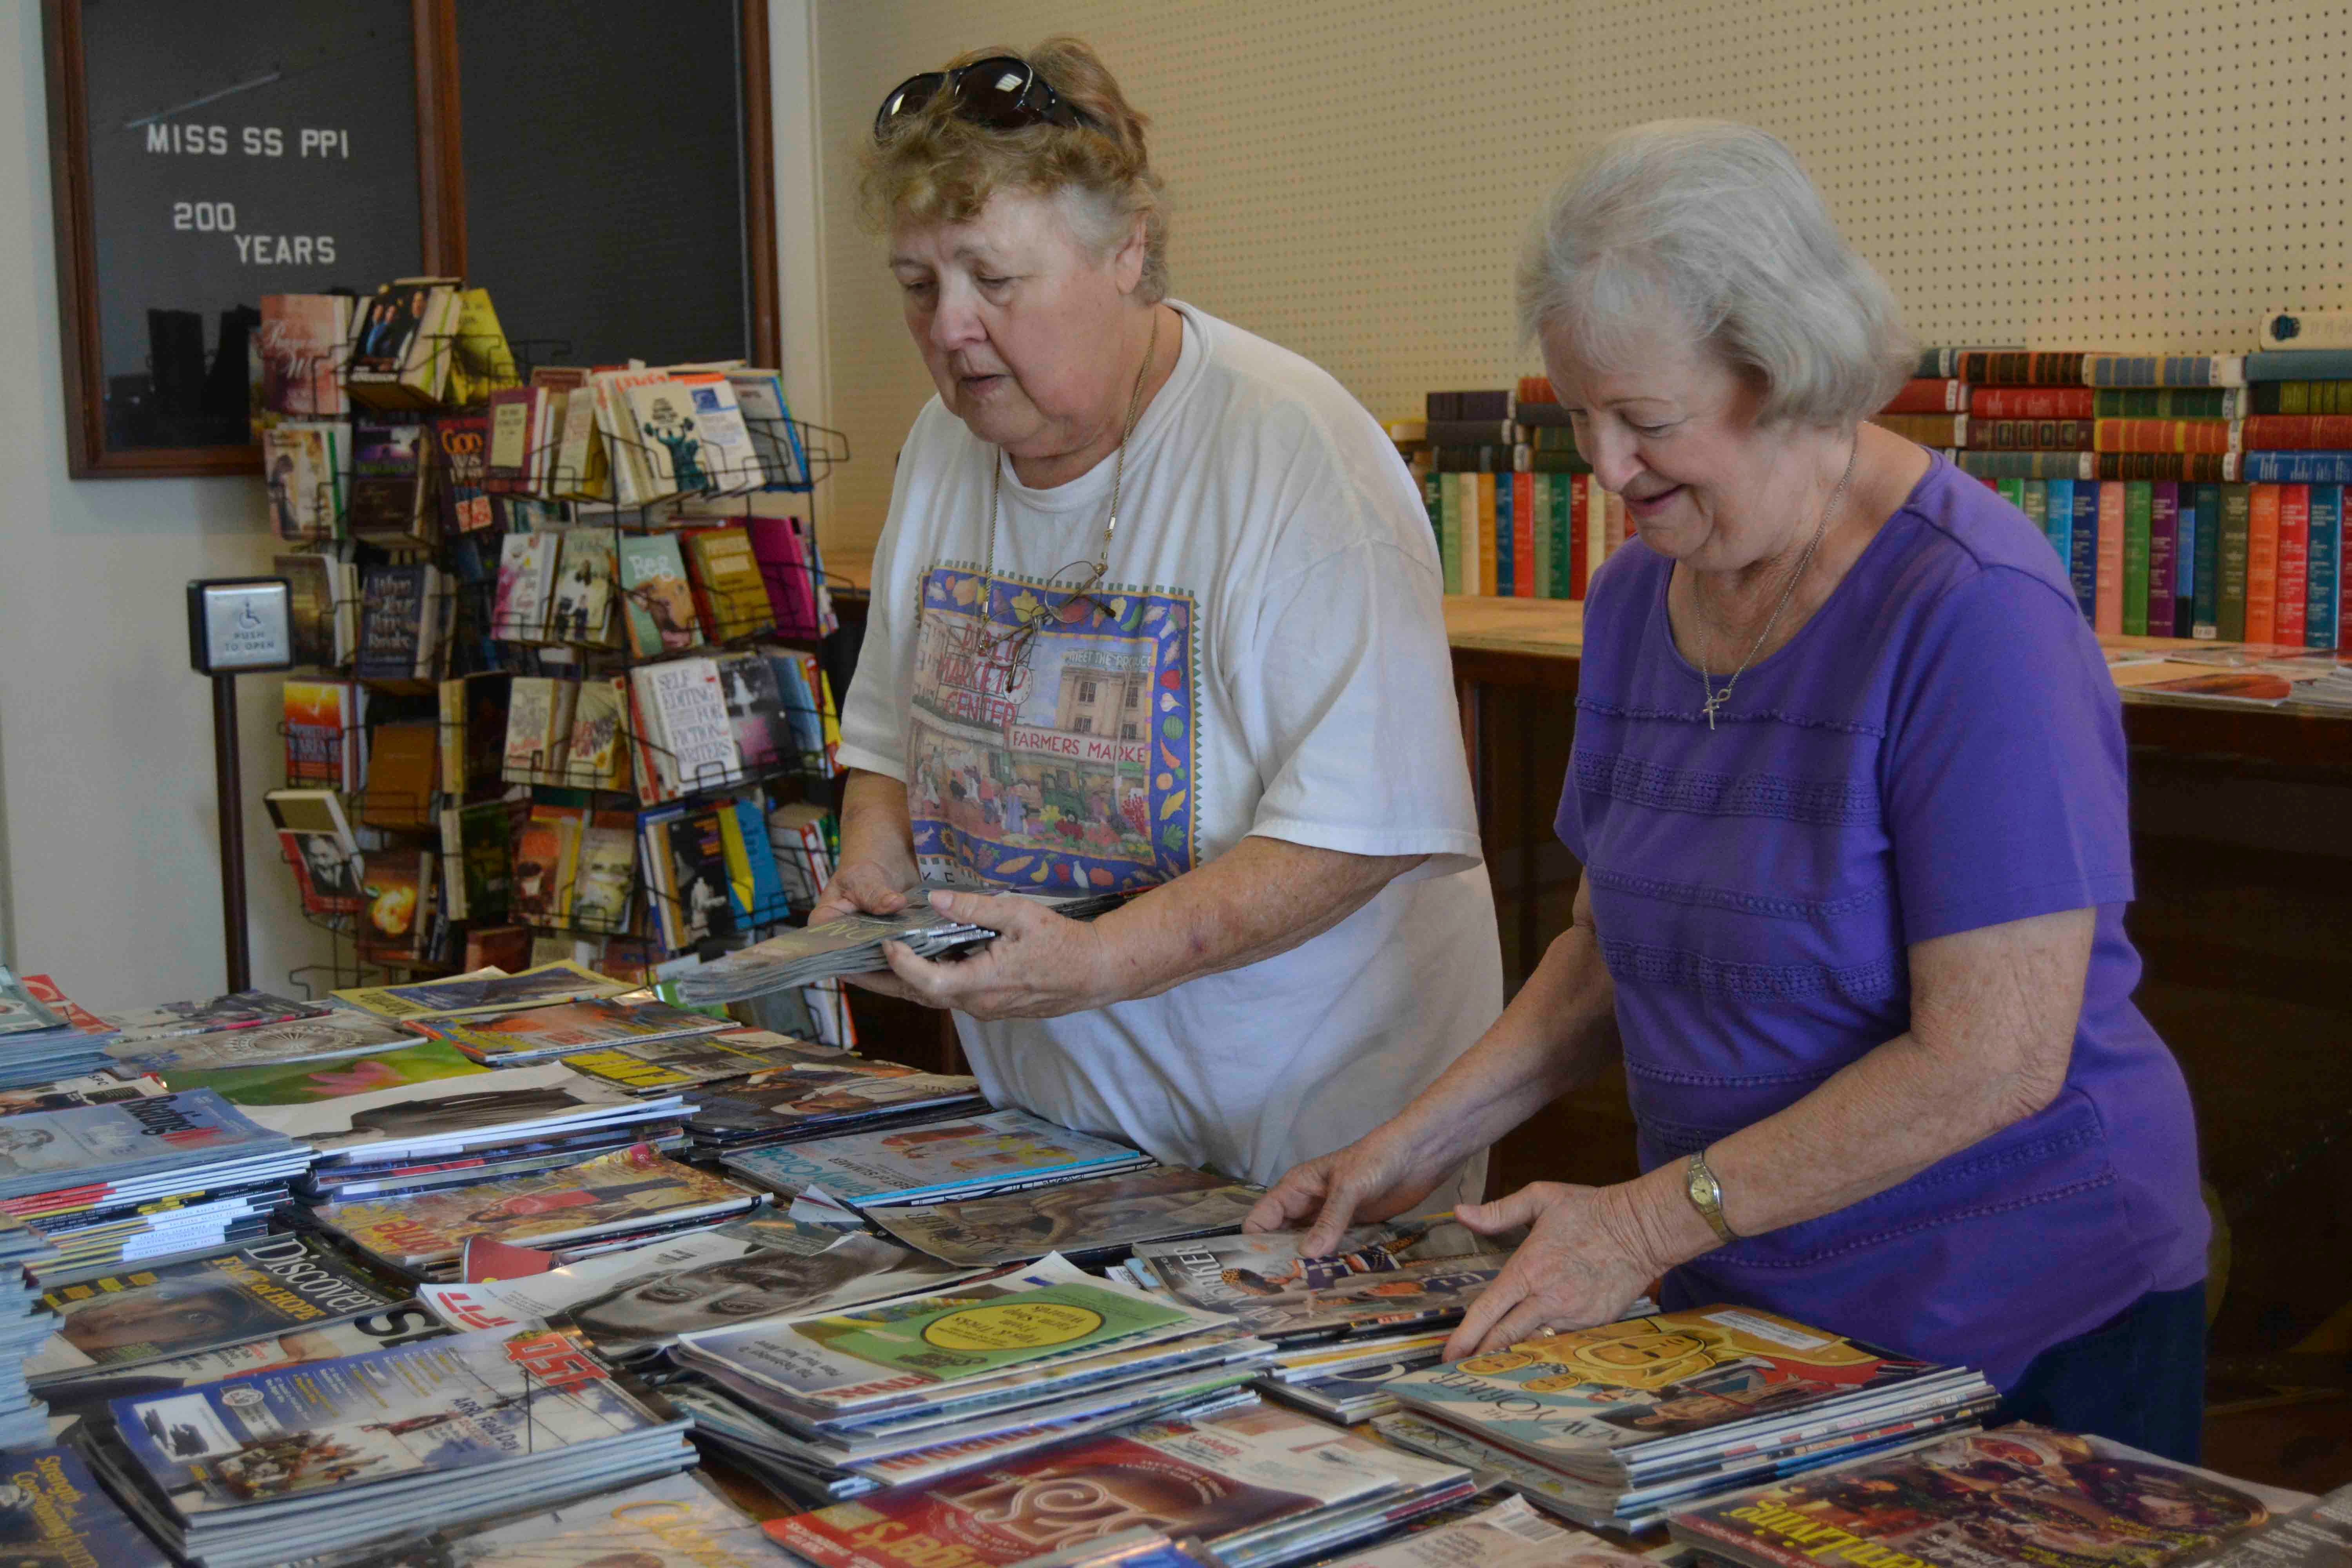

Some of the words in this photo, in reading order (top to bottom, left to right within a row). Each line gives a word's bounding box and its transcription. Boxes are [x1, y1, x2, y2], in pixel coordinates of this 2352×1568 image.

[147, 123, 227, 155] MISS
[242, 127, 284, 157] SS
[301, 129, 349, 158] PPI
[173, 201, 236, 232] 200
[234, 235, 336, 265] YEARS
[224, 642, 240, 652] TO
[244, 641, 275, 650] OPEN
[233, 631, 265, 640] PUSH
[1067, 649, 1093, 663] MEET
[1094, 650, 1112, 666] THE
[657, 670, 690, 692] SELF
[661, 686, 717, 711] EDITING
[943, 689, 1017, 729] CENTER
[695, 705, 724, 727] FOR
[1013, 730, 1080, 757] FARMERS
[244, 1237, 385, 1313] Discover
[270, 1288, 327, 1321] HOPE
[1002, 1307, 1033, 1323] Shop
[1029, 1305, 1087, 1324] Wizards
[951, 1316, 995, 1334] Tricks
[998, 1318, 1038, 1332] From
[503, 1332, 612, 1387] QST
[1428, 1371, 1559, 1422] YORKER
[1483, 1408, 1513, 1423] THE
[477, 1414, 506, 1434] Field
[498, 1430, 521, 1451] Day
[1720, 1499, 1863, 1558] Living
